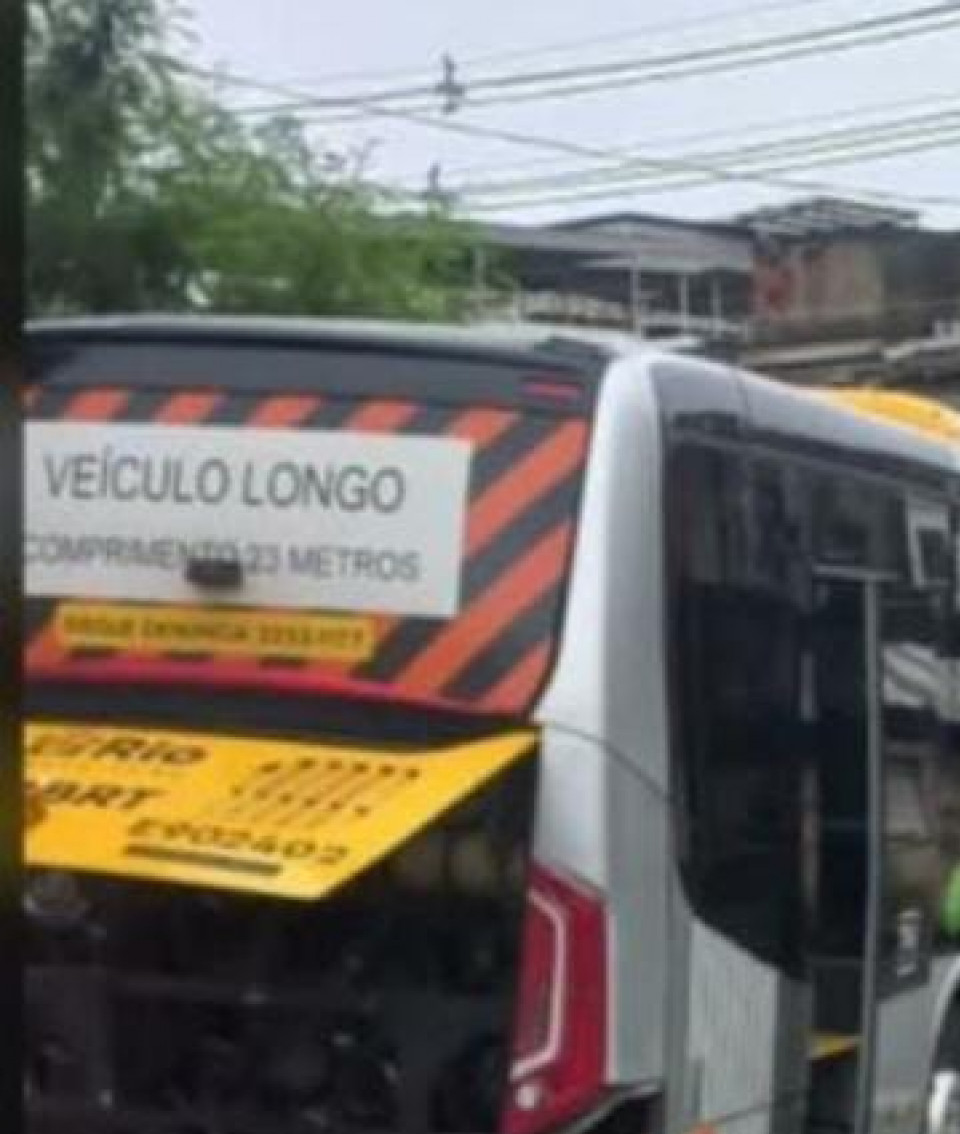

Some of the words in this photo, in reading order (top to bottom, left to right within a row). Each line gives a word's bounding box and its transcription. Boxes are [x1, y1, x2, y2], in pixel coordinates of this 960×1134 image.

[42, 444, 231, 504] VEÍCULO
[241, 460, 406, 513] LONGO
[287, 545, 420, 582] METROS
